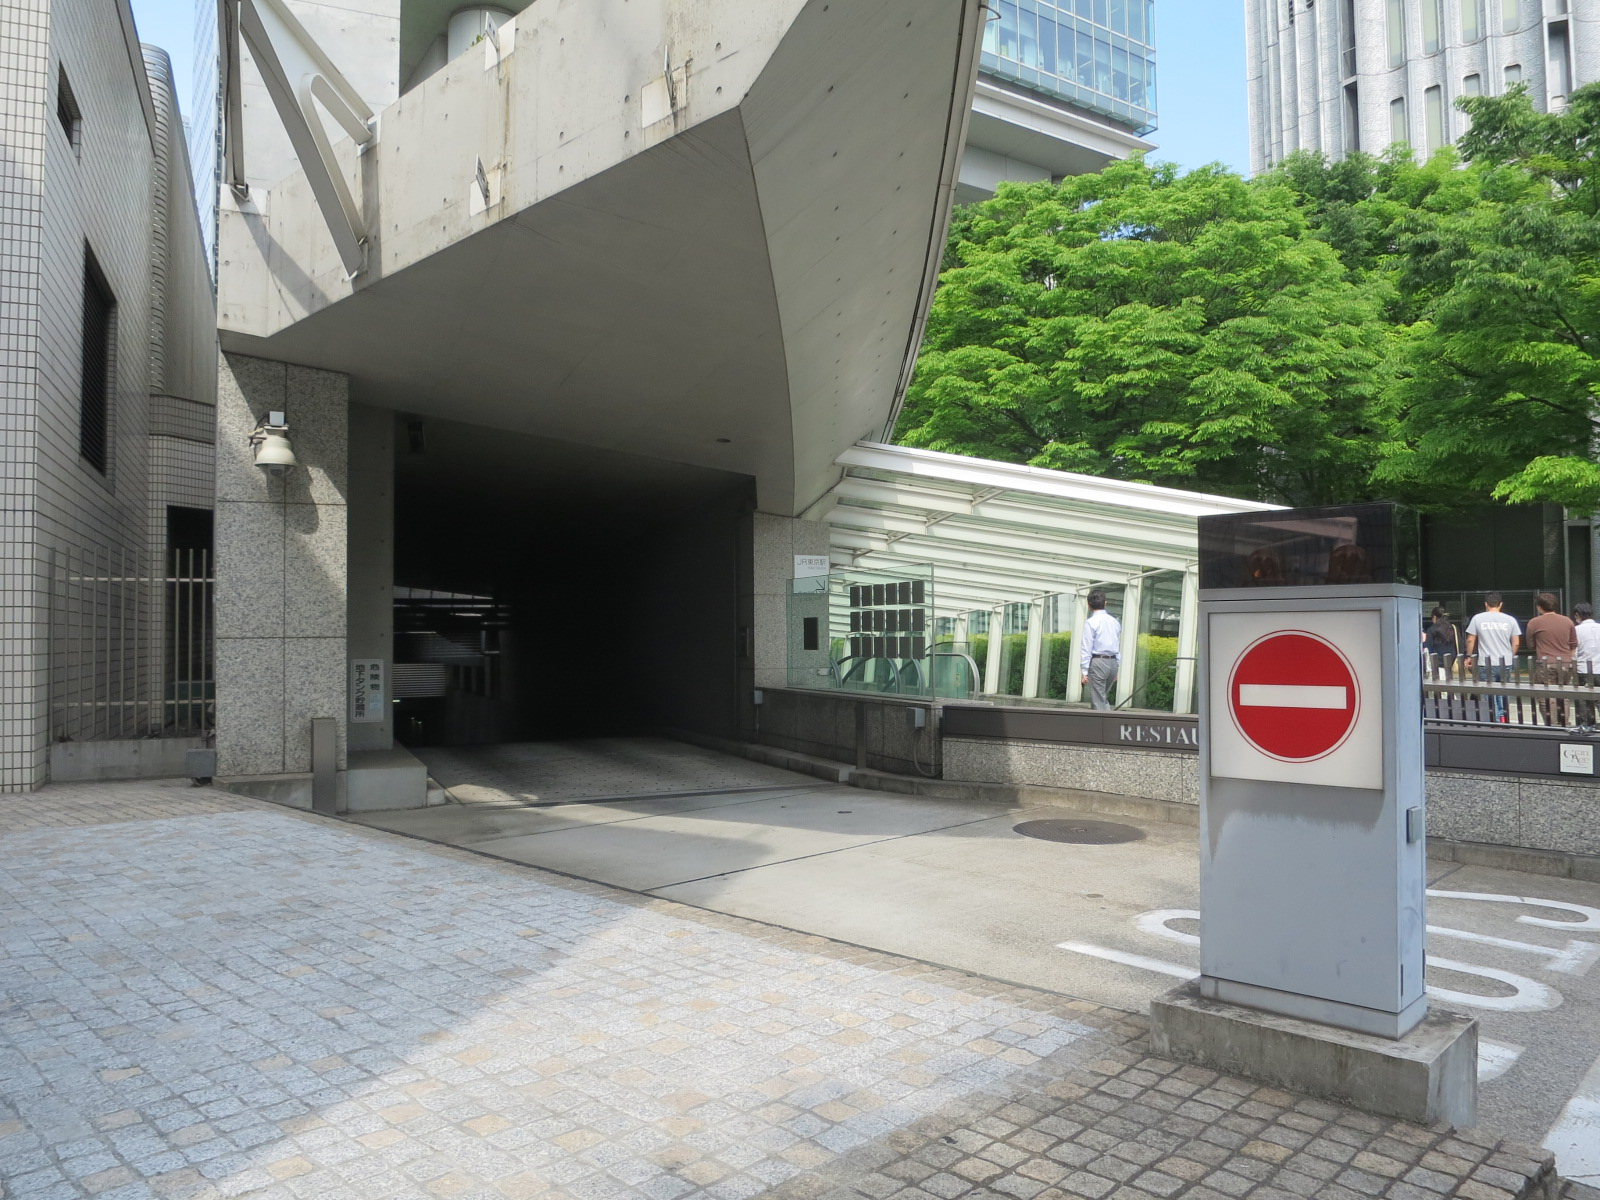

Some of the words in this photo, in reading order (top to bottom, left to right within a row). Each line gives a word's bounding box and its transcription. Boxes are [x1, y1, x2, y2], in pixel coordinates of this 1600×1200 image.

[354, 663, 366, 718] 地下タンク貯蔵所
[370, 663, 380, 691] 危険物
